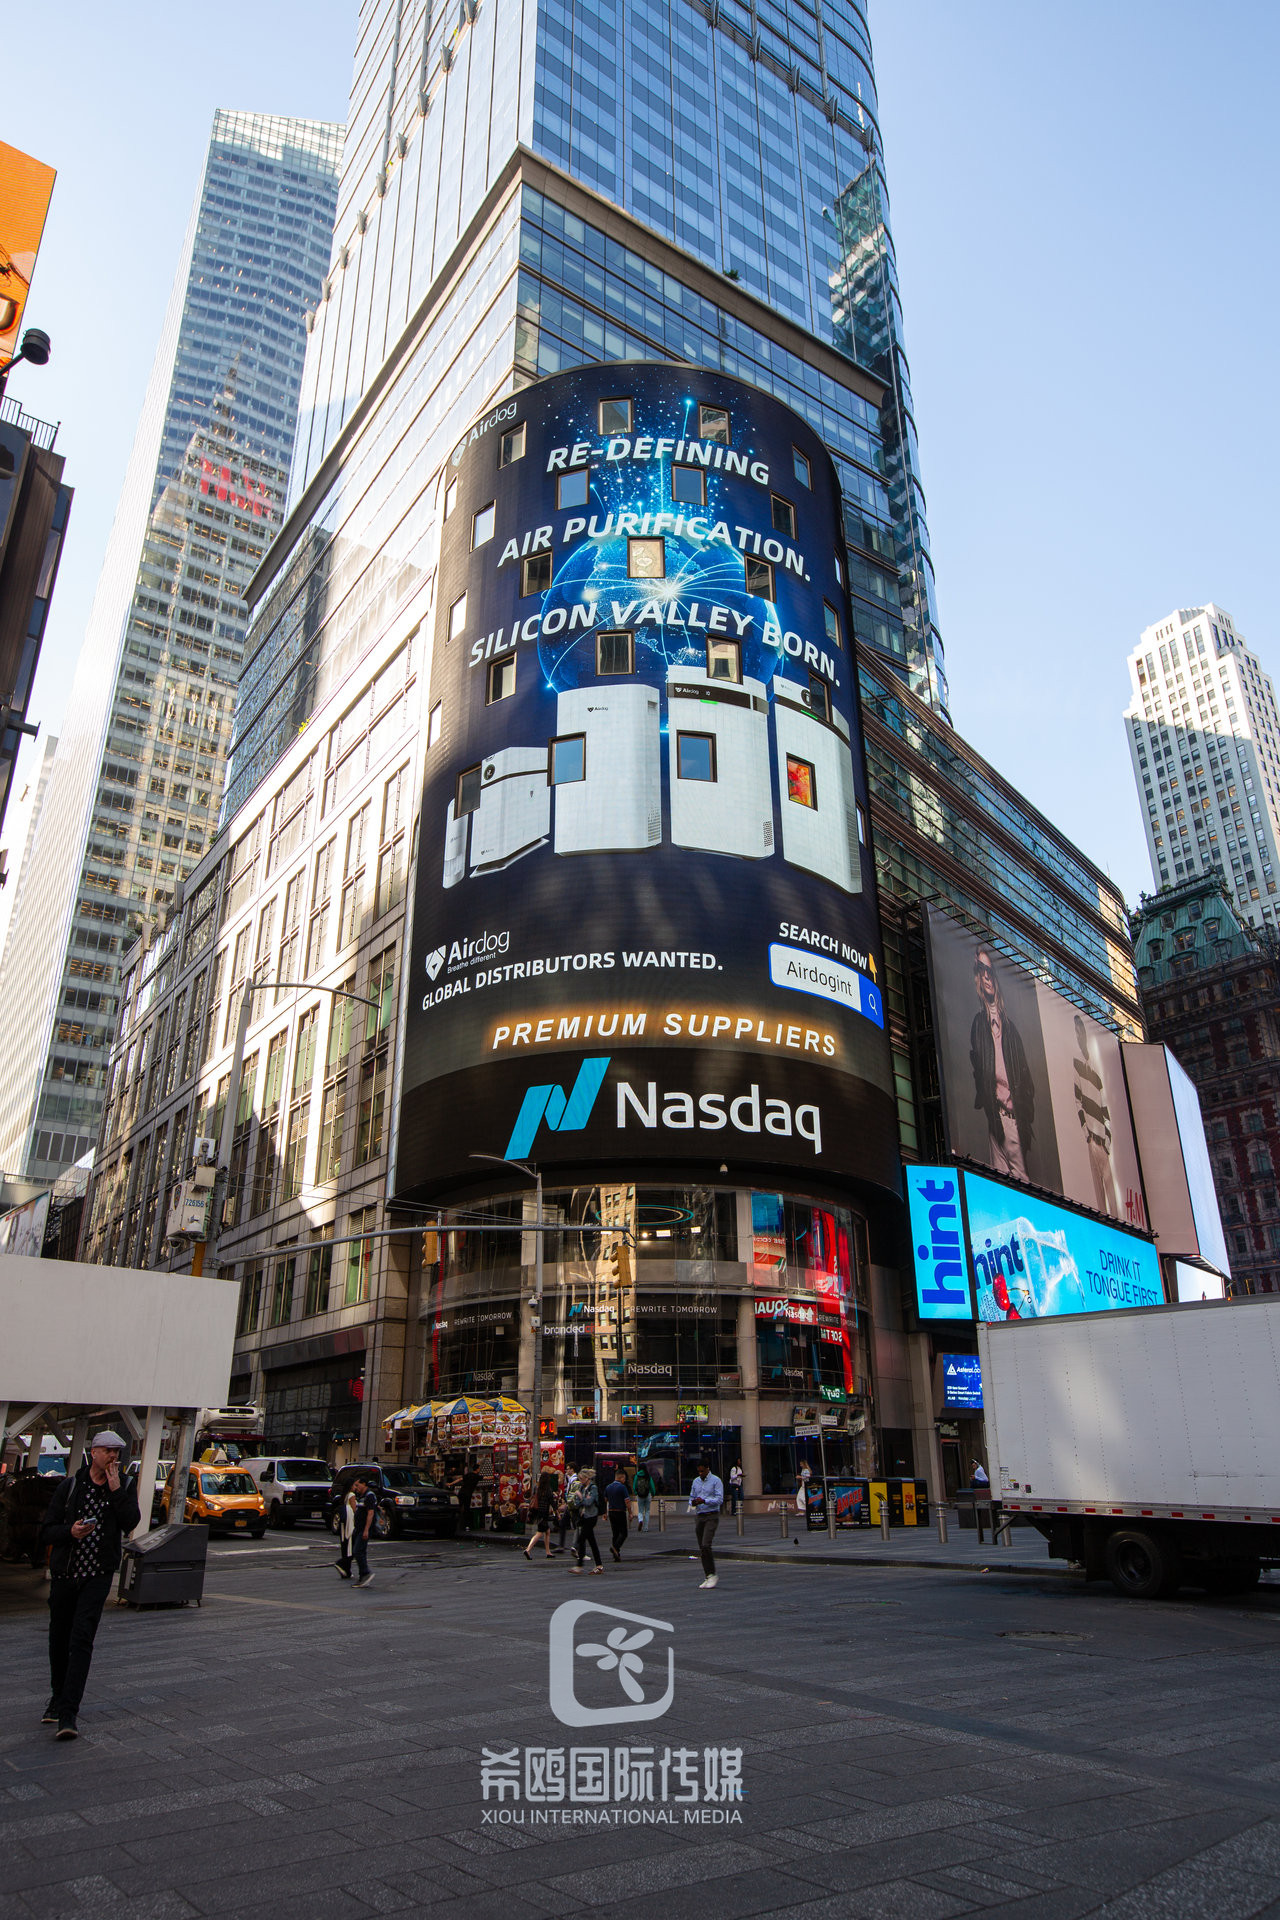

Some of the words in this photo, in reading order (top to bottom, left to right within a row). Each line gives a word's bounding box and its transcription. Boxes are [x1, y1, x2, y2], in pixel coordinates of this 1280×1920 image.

[468, 402, 517, 447] Airdog
[546, 437, 770, 486] RE-DEFINING
[497, 524, 554, 568] AIR
[563, 512, 811, 582] PURIFICATION.
[468, 601, 597, 669] SILICON
[611, 599, 753, 636] VALLEY
[762, 622, 841, 688] BORN.
[447, 930, 510, 965] Airdog
[447, 961, 469, 974] Breathe
[469, 952, 497, 966] different
[778, 922, 838, 955] SEARCH
[841, 942, 868, 970] NOW
[422, 977, 472, 1011] GLOBAL
[475, 952, 616, 989] DISTRIBUTORS
[622, 951, 724, 972] WANTED.
[786, 959, 853, 998] Airdogint
[492, 1013, 648, 1050] PREMIUM
[663, 1012, 837, 1057] SUPPLIERS
[616, 1081, 822, 1155] Nasdaq
[917, 1178, 966, 1305] hint
[1099, 1249, 1132, 1279] DRINK
[1132, 1260, 1141, 1282] IT
[1086, 1270, 1132, 1304] TONGUE
[1132, 1286, 1158, 1305] FIRST
[454, 1315, 475, 1326] REWRITE
[477, 1311, 513, 1322] TOMORROW
[583, 1304, 615, 1315] Nasdaq
[630, 1305, 667, 1313] REWRITE
[670, 1305, 718, 1314] TOMORROW
[628, 1362, 673, 1377] Nasdaq
[783, 1366, 804, 1380] Nasdaq
[837, 1488, 863, 1515] AMAZE
